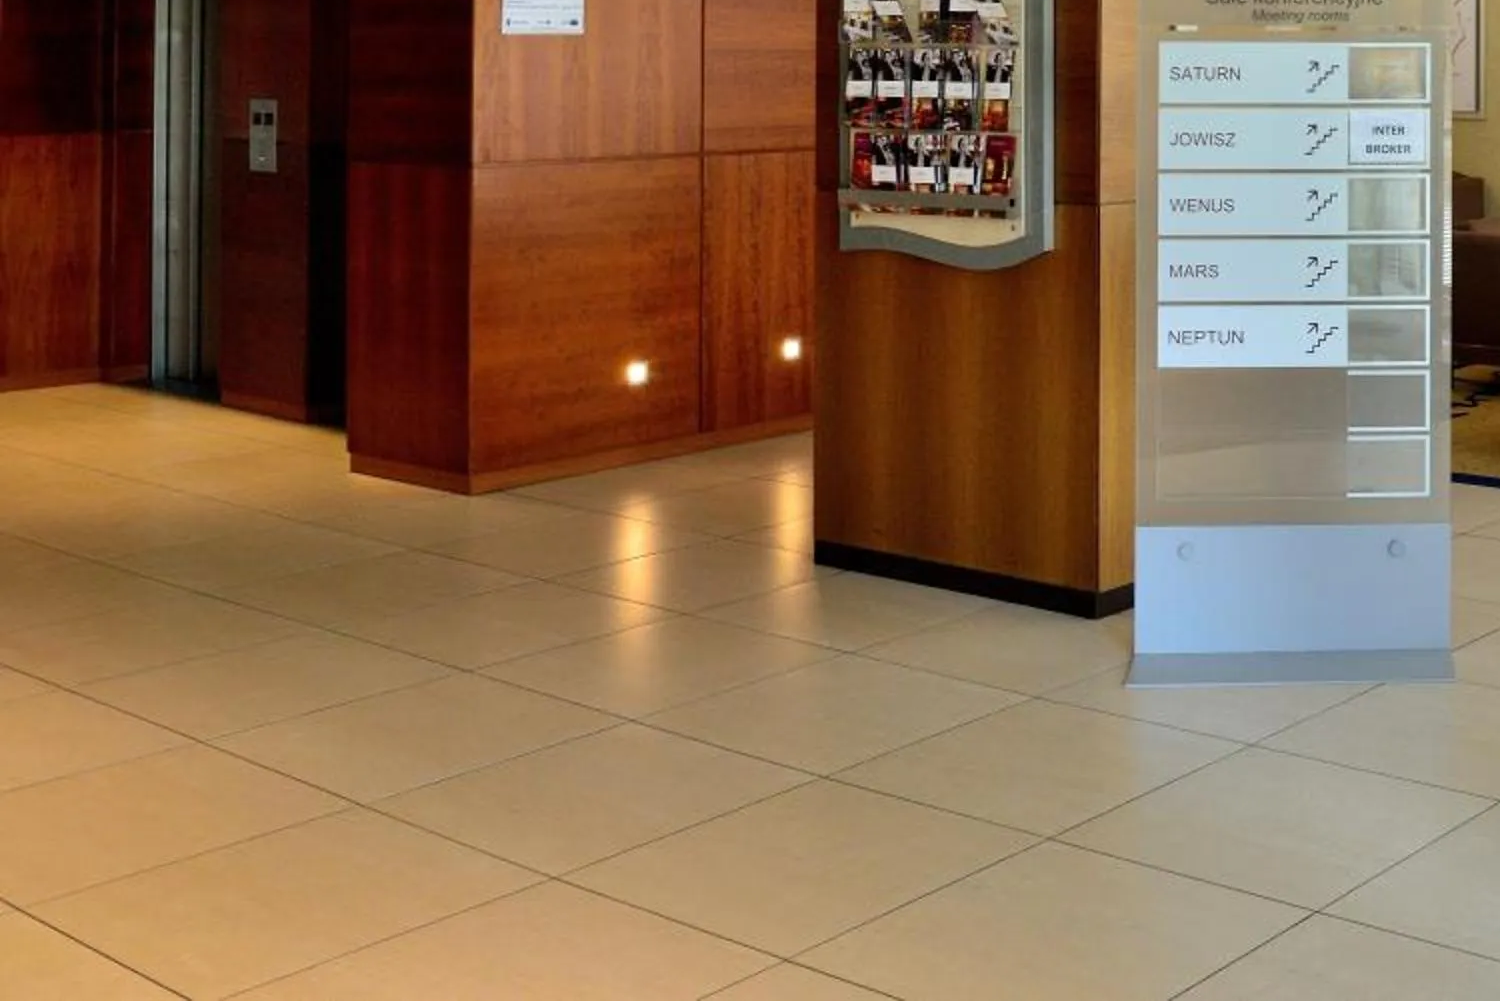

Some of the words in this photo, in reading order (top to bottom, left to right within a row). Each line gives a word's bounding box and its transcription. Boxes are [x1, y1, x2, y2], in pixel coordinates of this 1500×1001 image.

[1251, 9, 1304, 23] Meeting
[1307, 12, 1350, 22] rooms
[1168, 66, 1241, 81] SATURN
[1372, 125, 1405, 136] INTER
[1169, 132, 1237, 147] JOWISZ
[1365, 143, 1412, 154] BROKER
[1168, 198, 1236, 213] WENUS
[1168, 264, 1220, 279] MARS
[1167, 330, 1245, 345] NEPTUN
